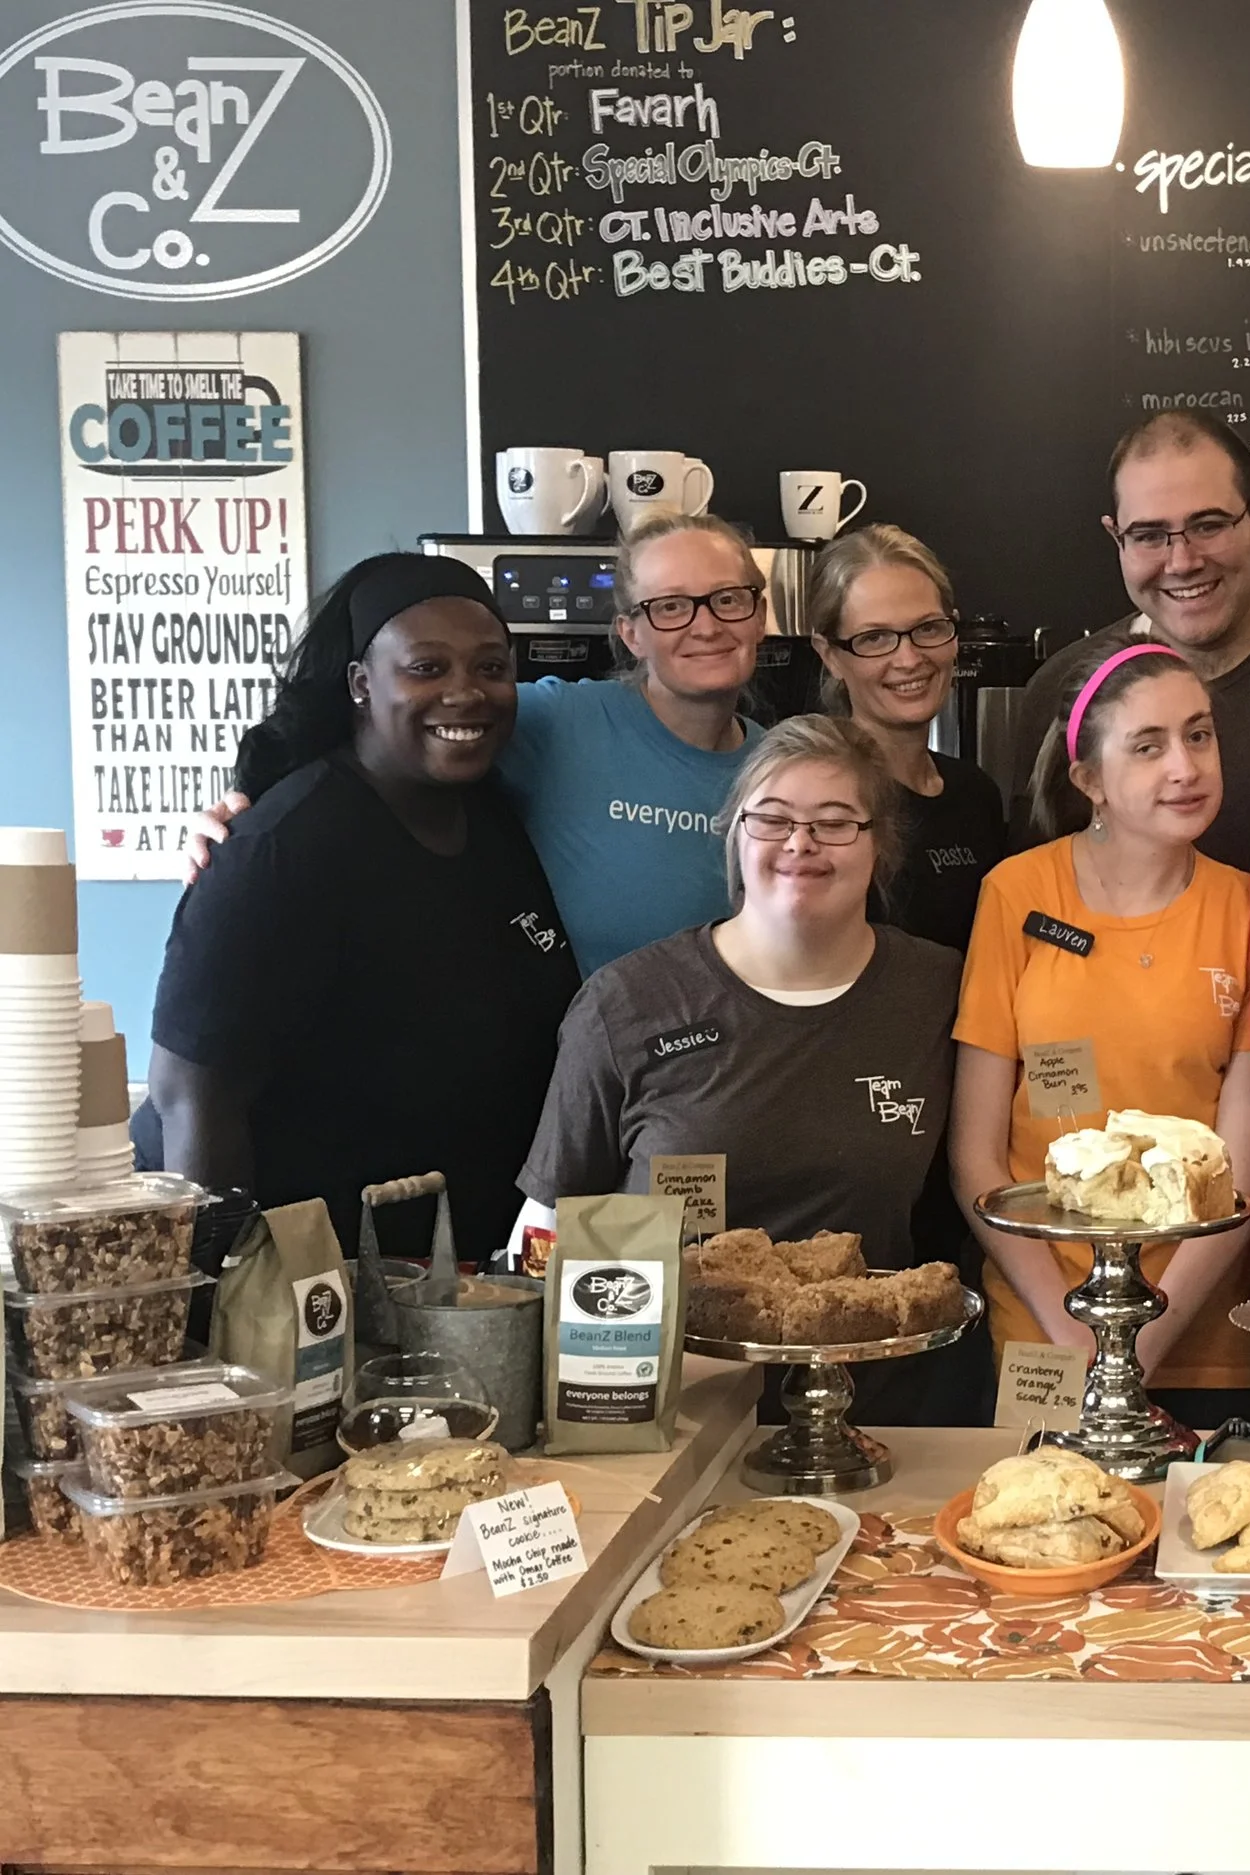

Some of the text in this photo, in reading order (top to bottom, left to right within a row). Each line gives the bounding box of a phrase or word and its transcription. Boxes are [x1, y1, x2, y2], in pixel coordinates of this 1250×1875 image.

[504, 7, 606, 55] BeanZ
[548, 60, 694, 89] portion donated to
[486, 83, 720, 138] 1st Favarh
[34, 56, 307, 222] BeanZ
[152, 146, 189, 200] &
[489, 156, 525, 198] 2nd
[583, 142, 676, 203] Special
[88, 191, 210, 269] Co.
[489, 206, 532, 249] 3rd
[654, 204, 796, 242] Inclusive
[803, 194, 880, 238] Arts
[490, 261, 540, 304] 4th
[612, 248, 713, 297] Best
[1145, 328, 1232, 355] hibiscus
[108, 373, 242, 399] TAKE TIME TO SMELL THE
[70, 403, 293, 462] COFFEE
[797, 485, 824, 511] Z
[83, 498, 288, 554] PERK UP!
[86, 558, 291, 605] Espresso Yourself
[88, 612, 291, 664] STAY GROUNDED
[91, 678, 274, 720] BETTER LATT
[93, 724, 247, 752] THAN NEV
[94, 765, 203, 813] TAKE LIFE
[136, 825, 167, 851] AT
[925, 843, 977, 873] pasta
[1038, 916, 1088, 952] Lauren
[653, 1029, 707, 1057] Jessie
[1028, 1068, 1078, 1081] Cinnamon
[1042, 1079, 1067, 1089] Bun
[854, 1076, 902, 1113] Team
[879, 1098, 925, 1135] BeanZ
[657, 1172, 716, 1185] Cinnamon
[664, 1184, 703, 1196] Crumb
[590, 1276, 635, 1304] BeanZ
[569, 1329, 651, 1342] BeanZ Blend
[565, 1389, 649, 1402] everyone belongs
[497, 1491, 533, 1514] New!
[480, 1517, 516, 1540] BeanZ
[492, 1555, 522, 1572] Mocha
[525, 1546, 546, 1561] Chip
